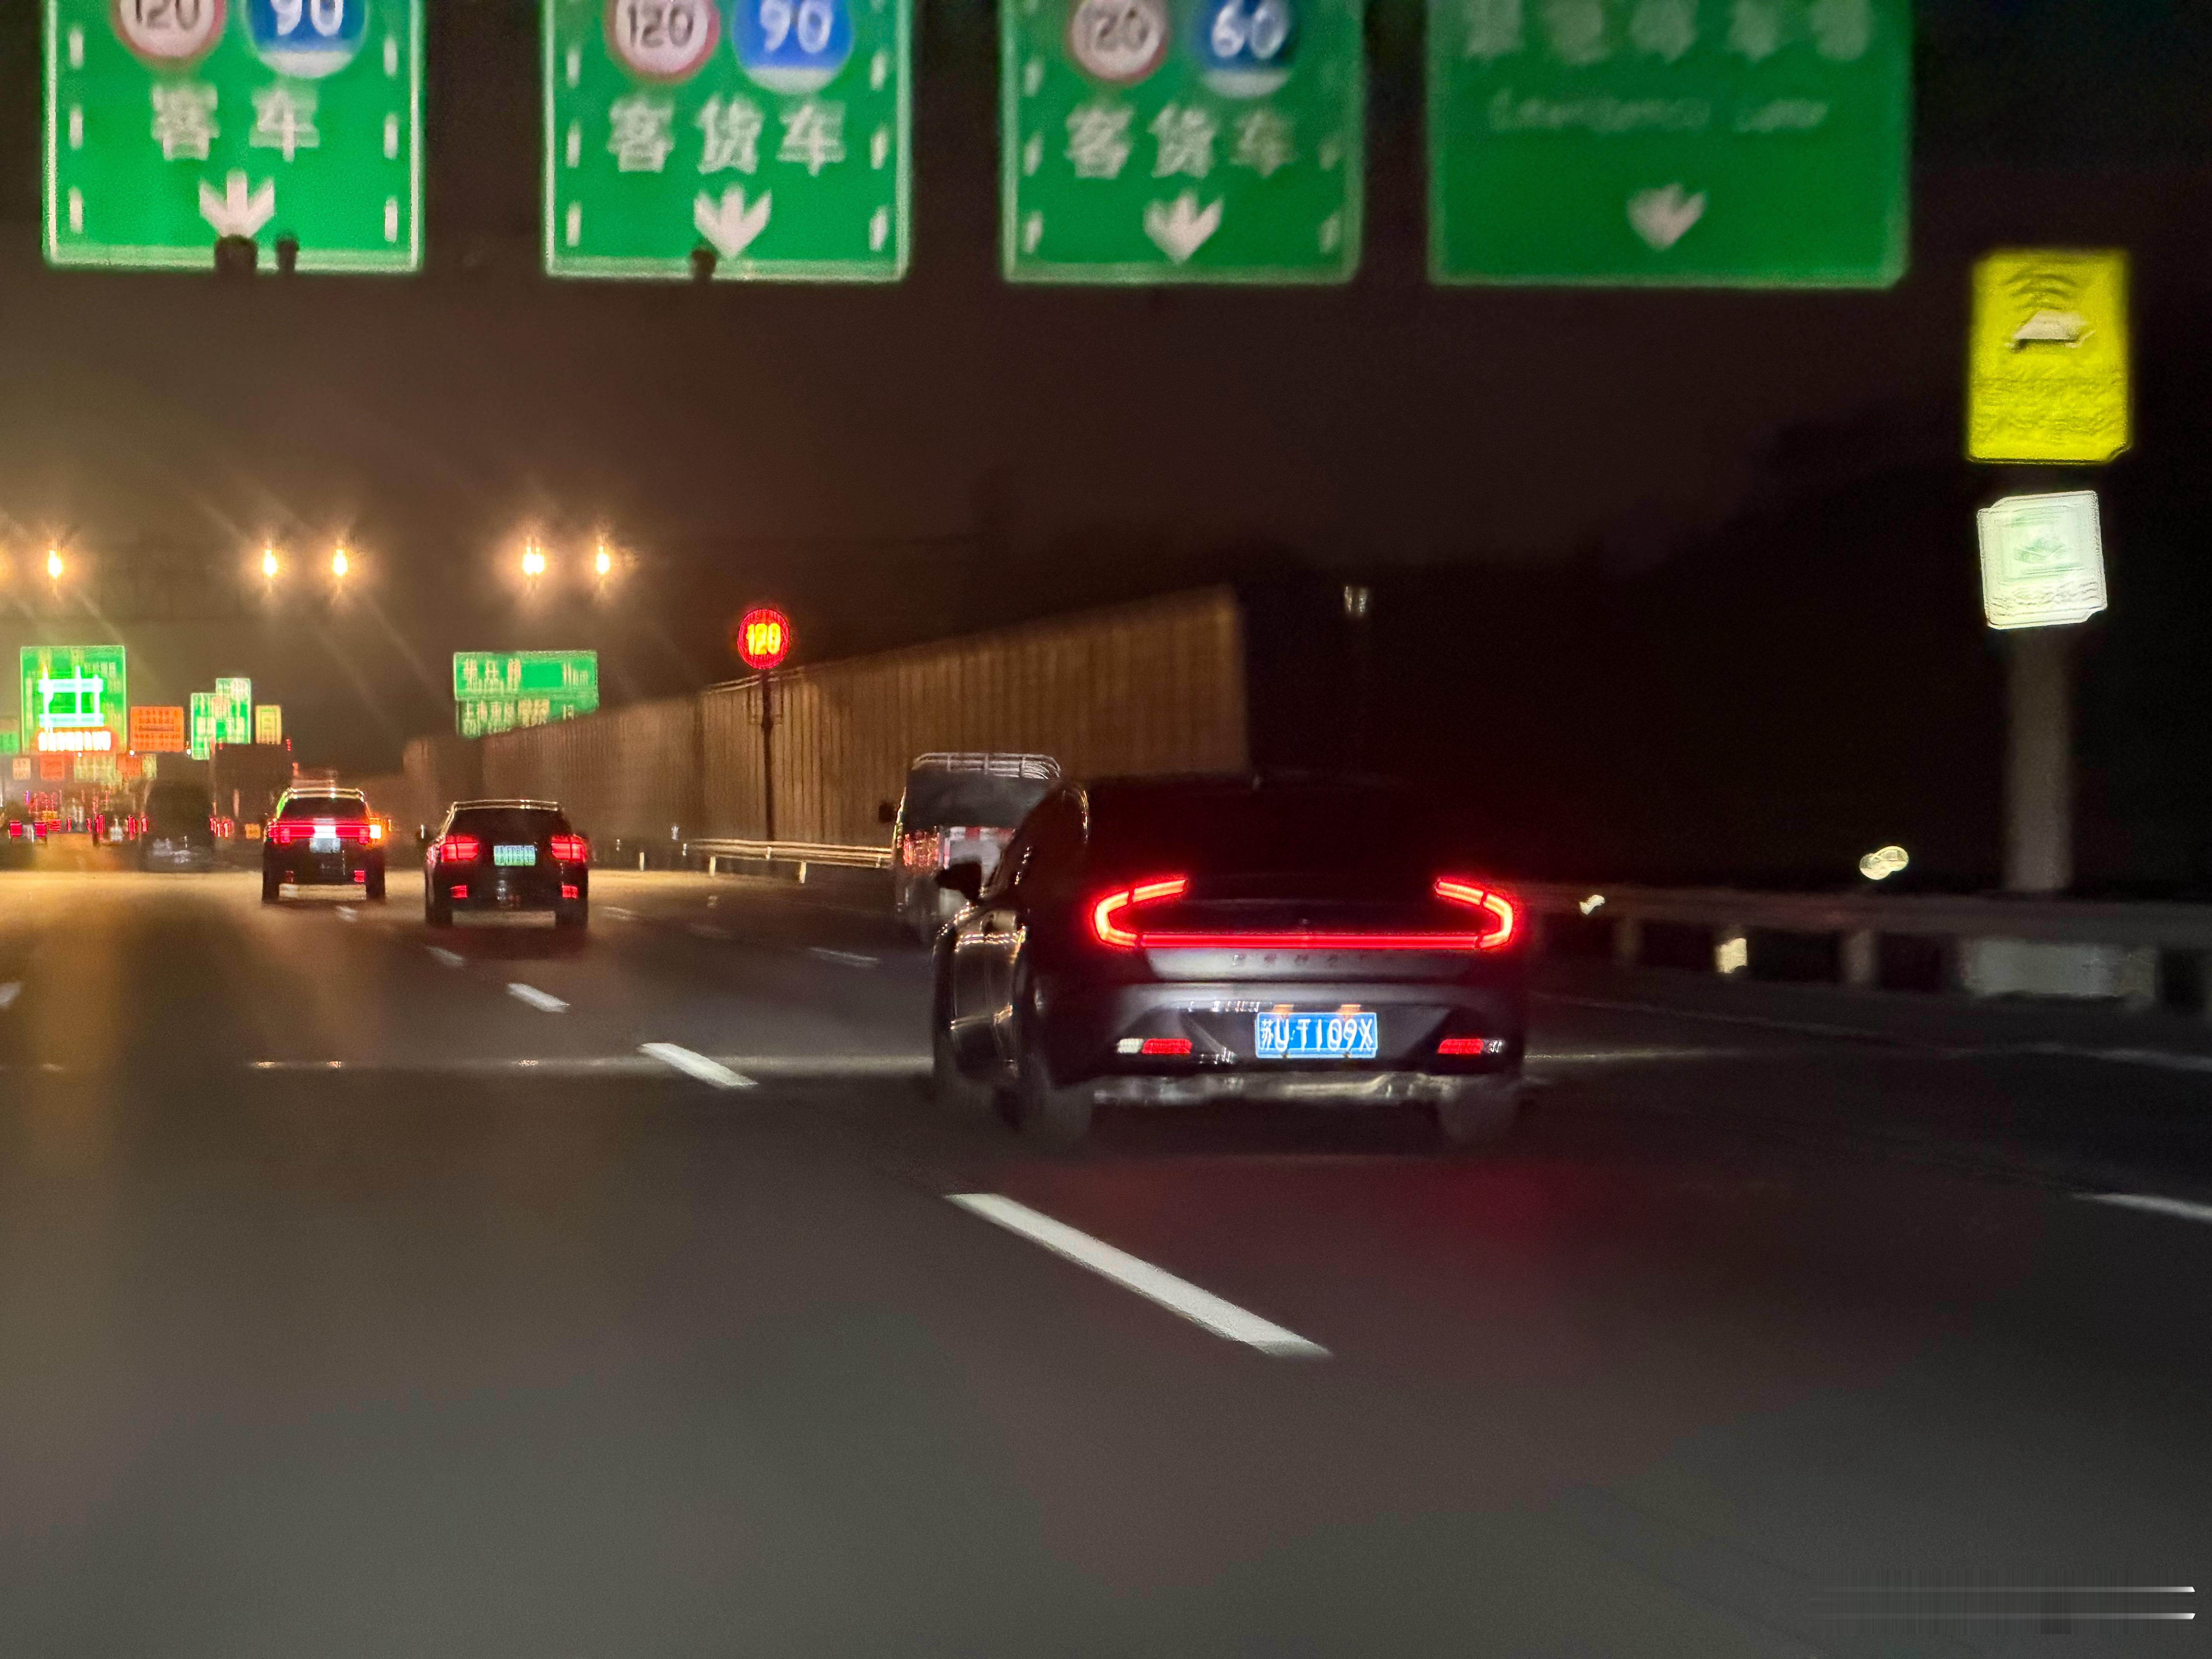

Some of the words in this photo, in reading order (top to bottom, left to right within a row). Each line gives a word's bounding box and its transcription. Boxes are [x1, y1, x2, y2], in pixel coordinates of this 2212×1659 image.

[135, 0, 200, 31] 120
[271, 0, 343, 37] 90
[627, 4, 694, 48] 120
[759, 0, 831, 53] 90
[1212, 0, 1289, 59] 60
[745, 623, 781, 655] 120
